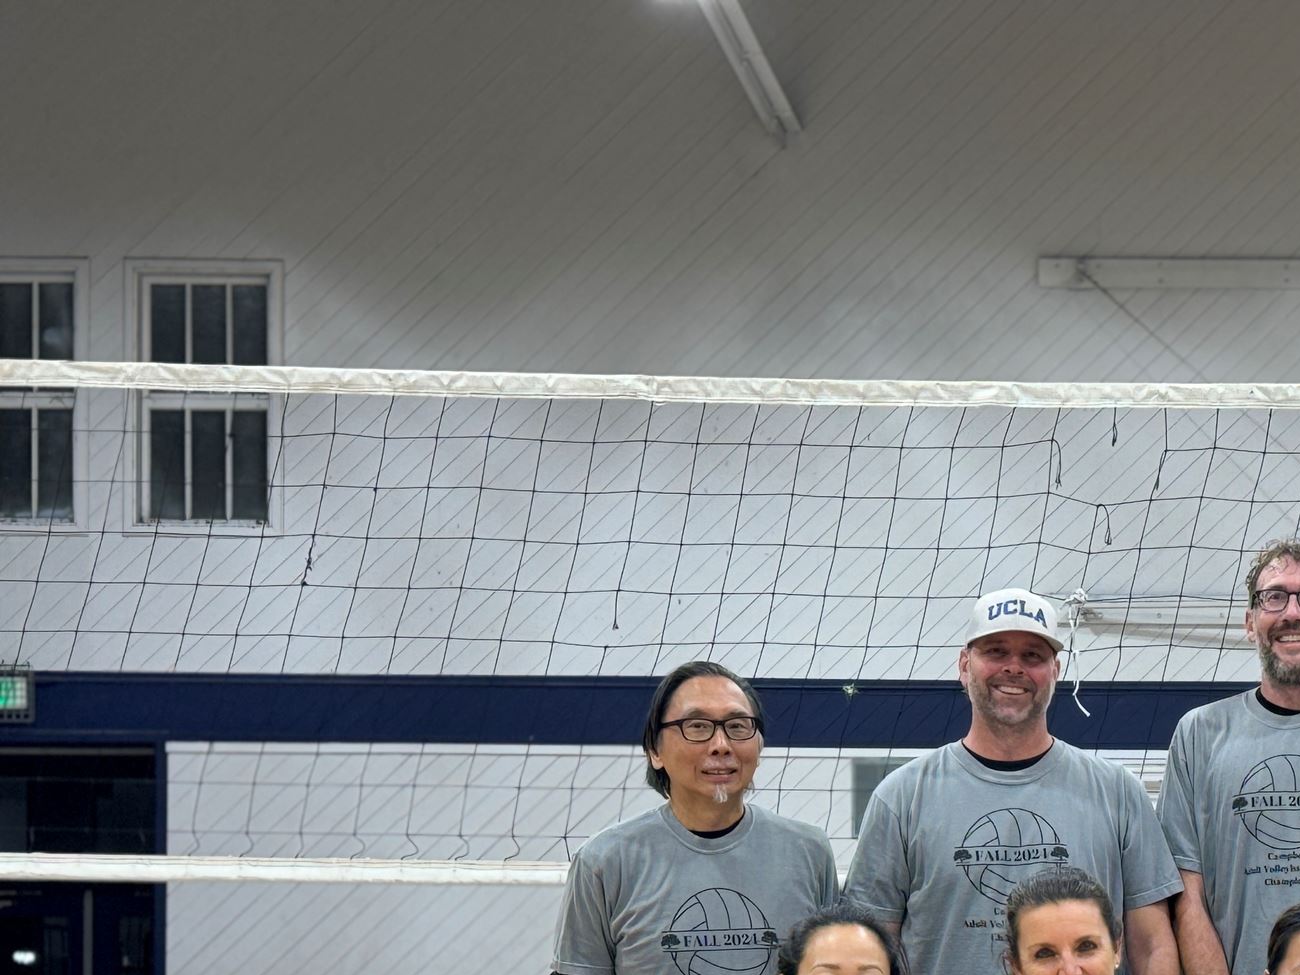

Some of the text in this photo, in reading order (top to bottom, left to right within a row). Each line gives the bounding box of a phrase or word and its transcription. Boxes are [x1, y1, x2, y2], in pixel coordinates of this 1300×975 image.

[987, 599, 1047, 629] UCLA
[1251, 795, 1286, 807] FALL
[975, 848, 1048, 862] FALL 2024
[683, 933, 759, 948] FALL 2024
